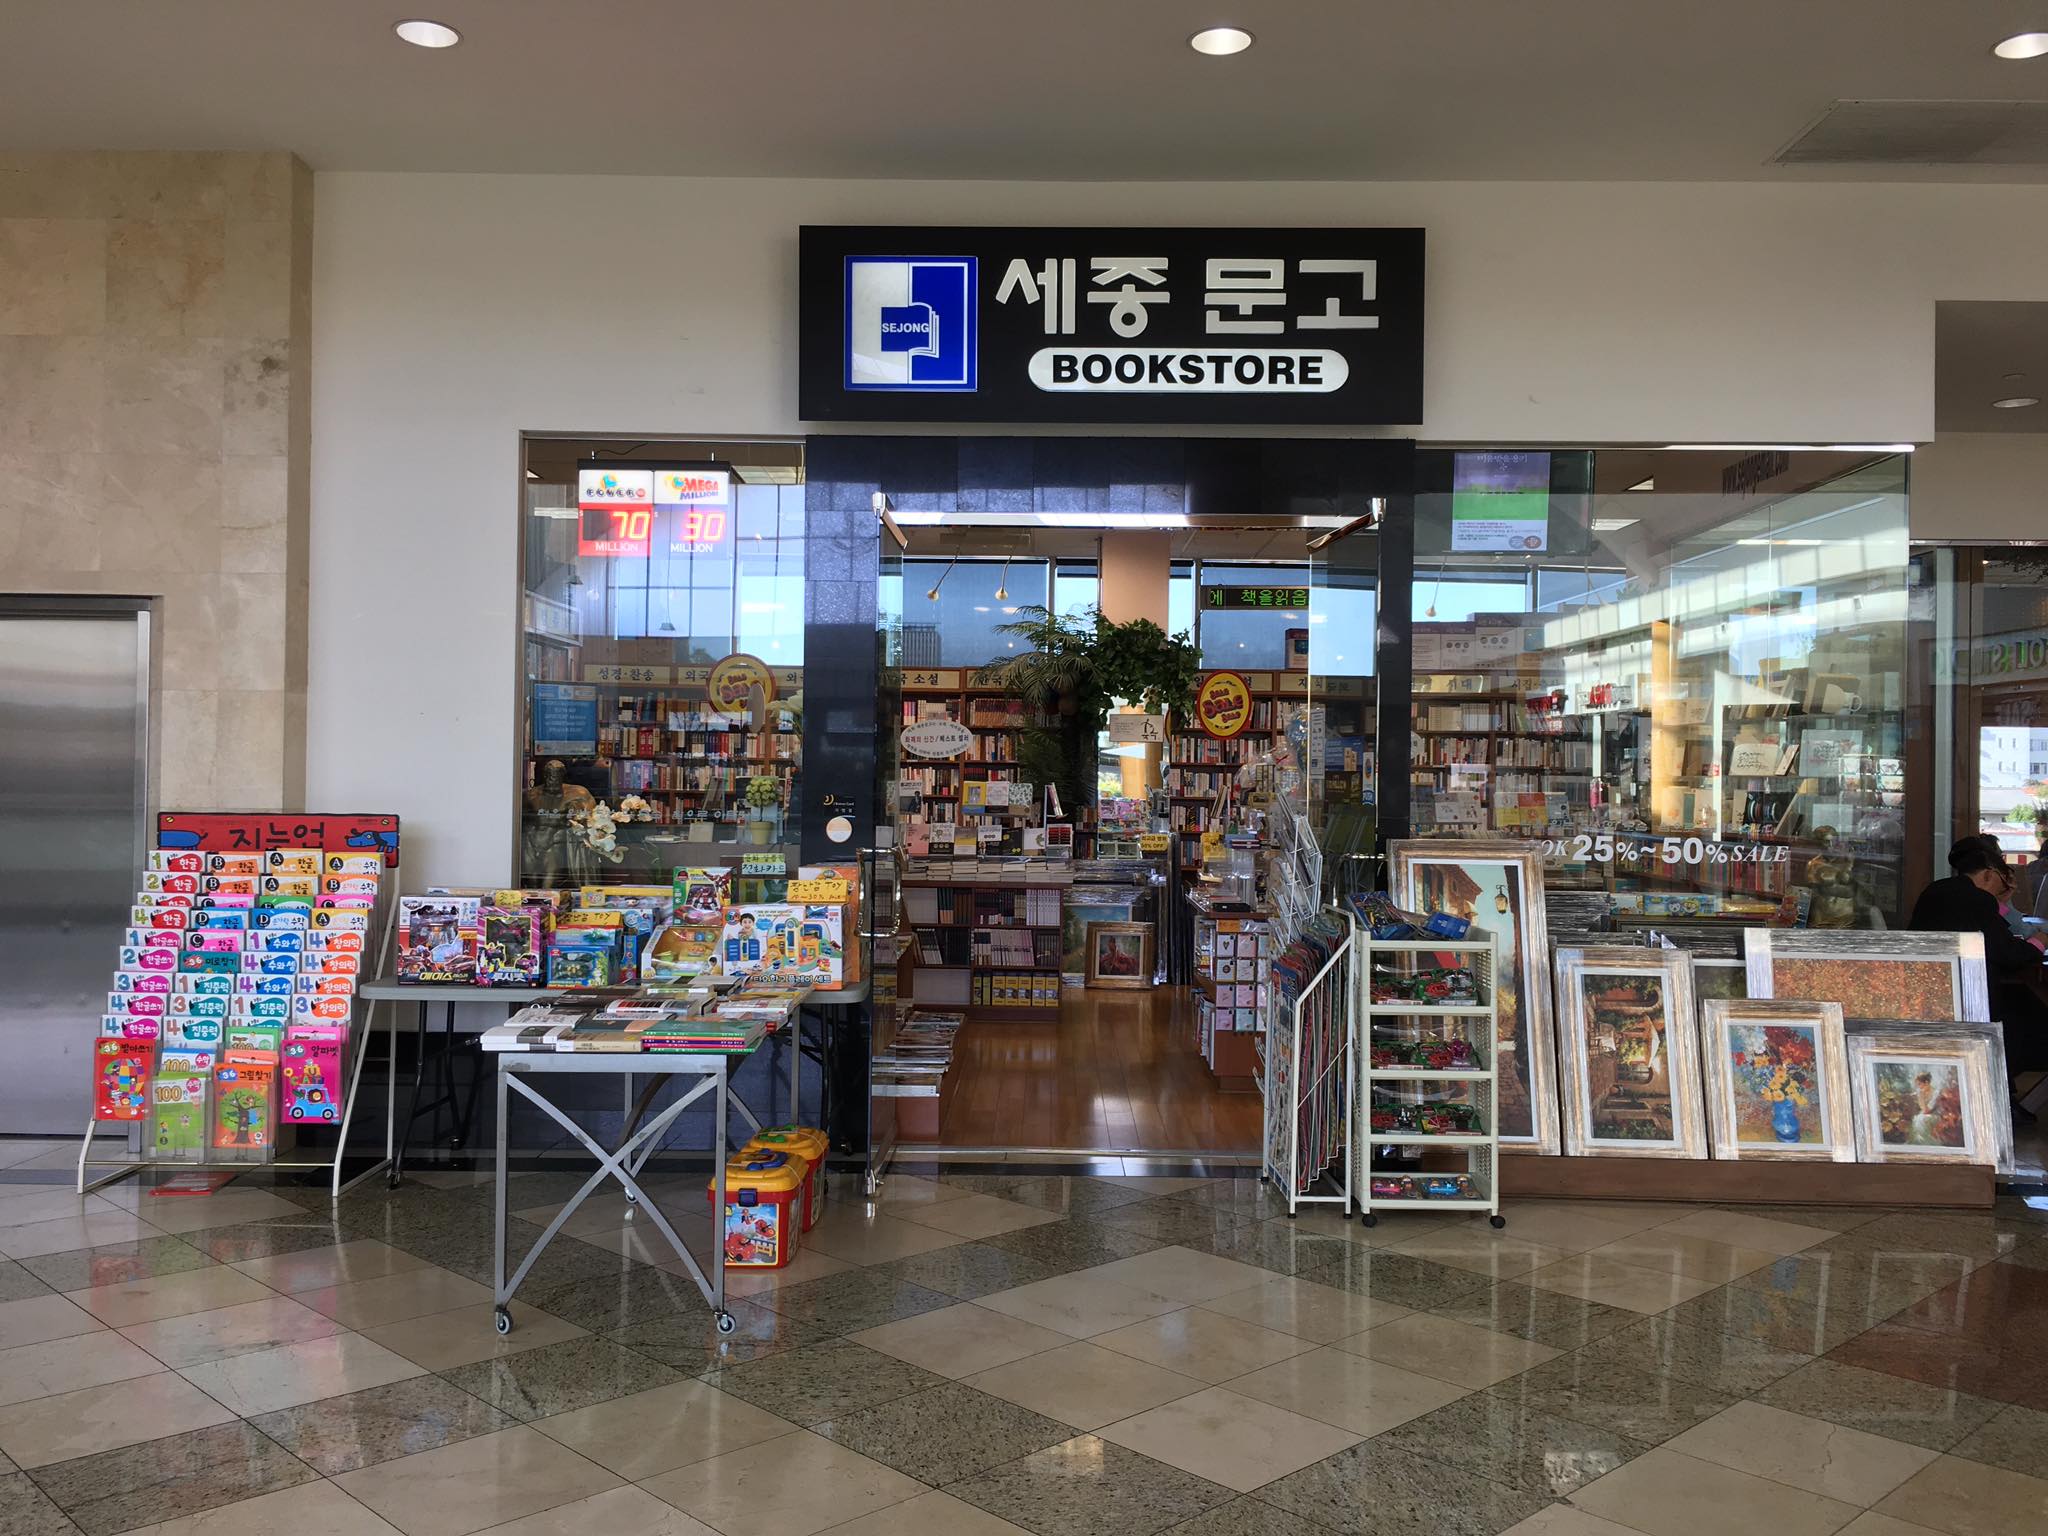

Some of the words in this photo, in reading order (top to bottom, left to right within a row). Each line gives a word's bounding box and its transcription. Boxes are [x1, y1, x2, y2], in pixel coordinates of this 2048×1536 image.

[995, 257, 1171, 338] 세종
[1204, 258, 1379, 335] 문고
[881, 322, 930, 334] SEJONG
[1052, 354, 1324, 386] BOOKSTORE
[684, 477, 719, 491] MEGA
[613, 511, 651, 541] 70
[682, 511, 725, 541] 30
[595, 542, 640, 552] MILLION
[670, 543, 714, 553] MILLION
[913, 673, 940, 685] 소설
[152, 852, 161, 869] 1
[179, 857, 198, 871] 한글
[273, 854, 281, 863] A
[1730, 844, 1792, 863] SALE
[215, 857, 222, 867] B
[332, 859, 340, 867] A
[147, 873, 159, 890] 2
[174, 879, 193, 892] 한글
[210, 879, 217, 888] B
[268, 879, 276, 888] A
[330, 880, 338, 888] B
[134, 908, 148, 925] 4
[163, 915, 181, 927] 한글
[198, 915, 207, 923] D
[260, 917, 268, 925] D
[319, 914, 327, 922] A
[130, 930, 139, 946] 1
[192, 935, 201, 944] C
[250, 932, 260, 949] 1
[309, 932, 323, 948] 4
[123, 948, 136, 964] 2
[244, 954, 258, 970] 4
[305, 954, 319, 970] 4
[118, 974, 131, 991] 3
[179, 975, 189, 993] 1
[239, 976, 254, 993] 4
[300, 976, 314, 993] 4
[111, 994, 125, 1011] 4
[173, 995, 186, 1013] 3
[234, 996, 244, 1014] 1
[295, 996, 308, 1013] 3
[105, 1017, 120, 1034] 4
[167, 1018, 180, 1036] 4
[155, 1085, 182, 1102] 100
